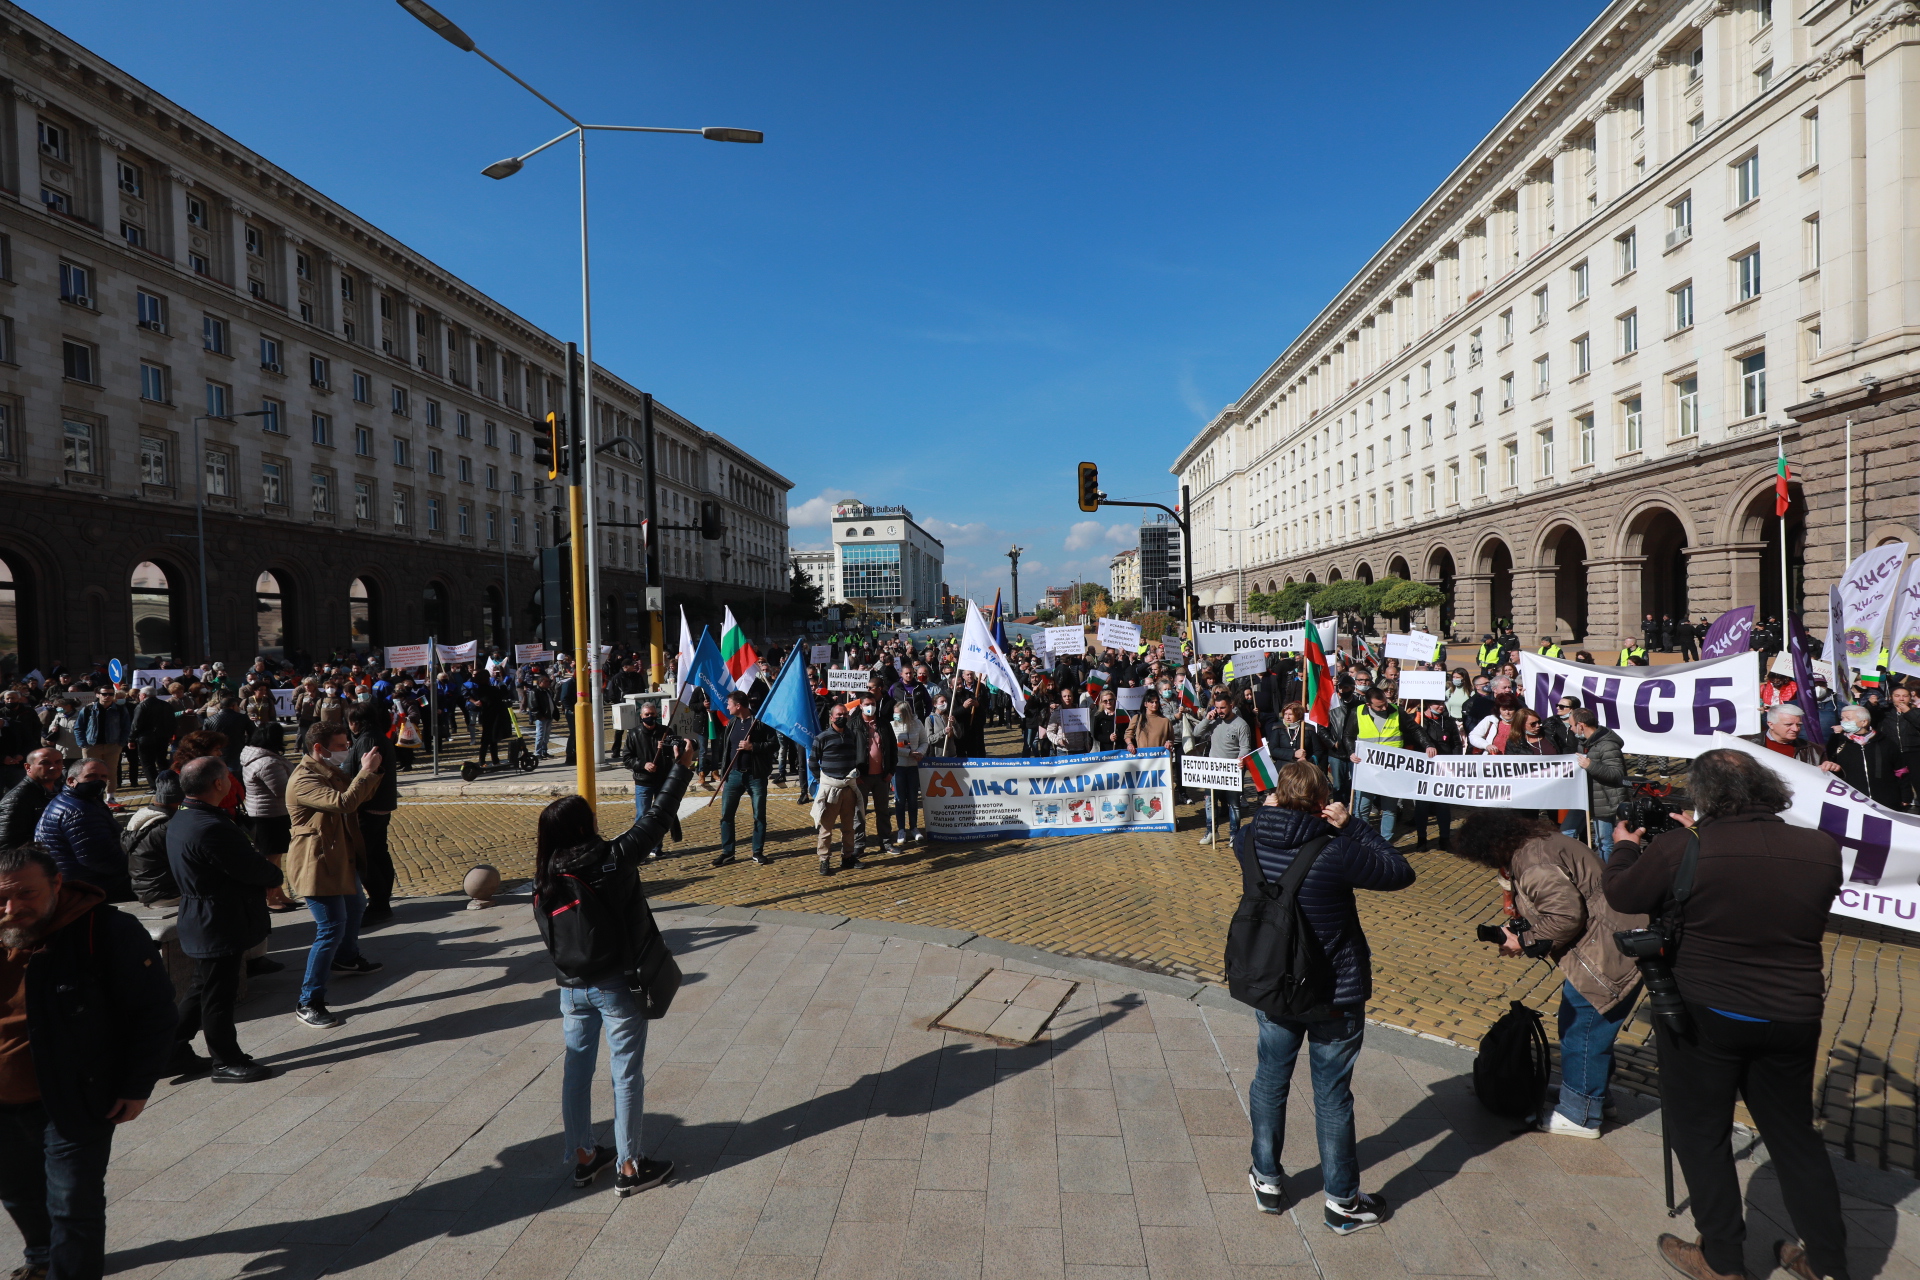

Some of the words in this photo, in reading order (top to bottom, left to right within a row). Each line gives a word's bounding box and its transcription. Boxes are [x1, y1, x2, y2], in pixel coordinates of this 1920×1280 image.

[848, 505, 875, 514] UniCredit
[876, 504, 902, 513] Bulbank
[1844, 555, 1902, 592] КНСБ
[1848, 590, 1884, 612] КНСБ
[1199, 622, 1216, 634] НЕ
[1220, 623, 1236, 633] на
[1704, 617, 1752, 656] КНСБ
[1234, 635, 1293, 652] робство!
[1534, 672, 1737, 736] КНСБ
[1183, 759, 1209, 770] РЕСТОТО
[1210, 762, 1240, 775] ВЪРНЕТЕ,
[1366, 748, 1477, 778] ХИДРАВЛИЧНИ
[1482, 761, 1574, 779] ЕЛЕМЕНТИ
[968, 778, 1018, 796] М+С
[1028, 770, 1167, 796] ХИДРАВЛИК
[1184, 772, 1200, 783] ТОКА
[1202, 774, 1240, 786] НАМАЛЕТЕ!
[1417, 780, 1428, 795] И
[1433, 782, 1511, 800] СИСТЕМИ
